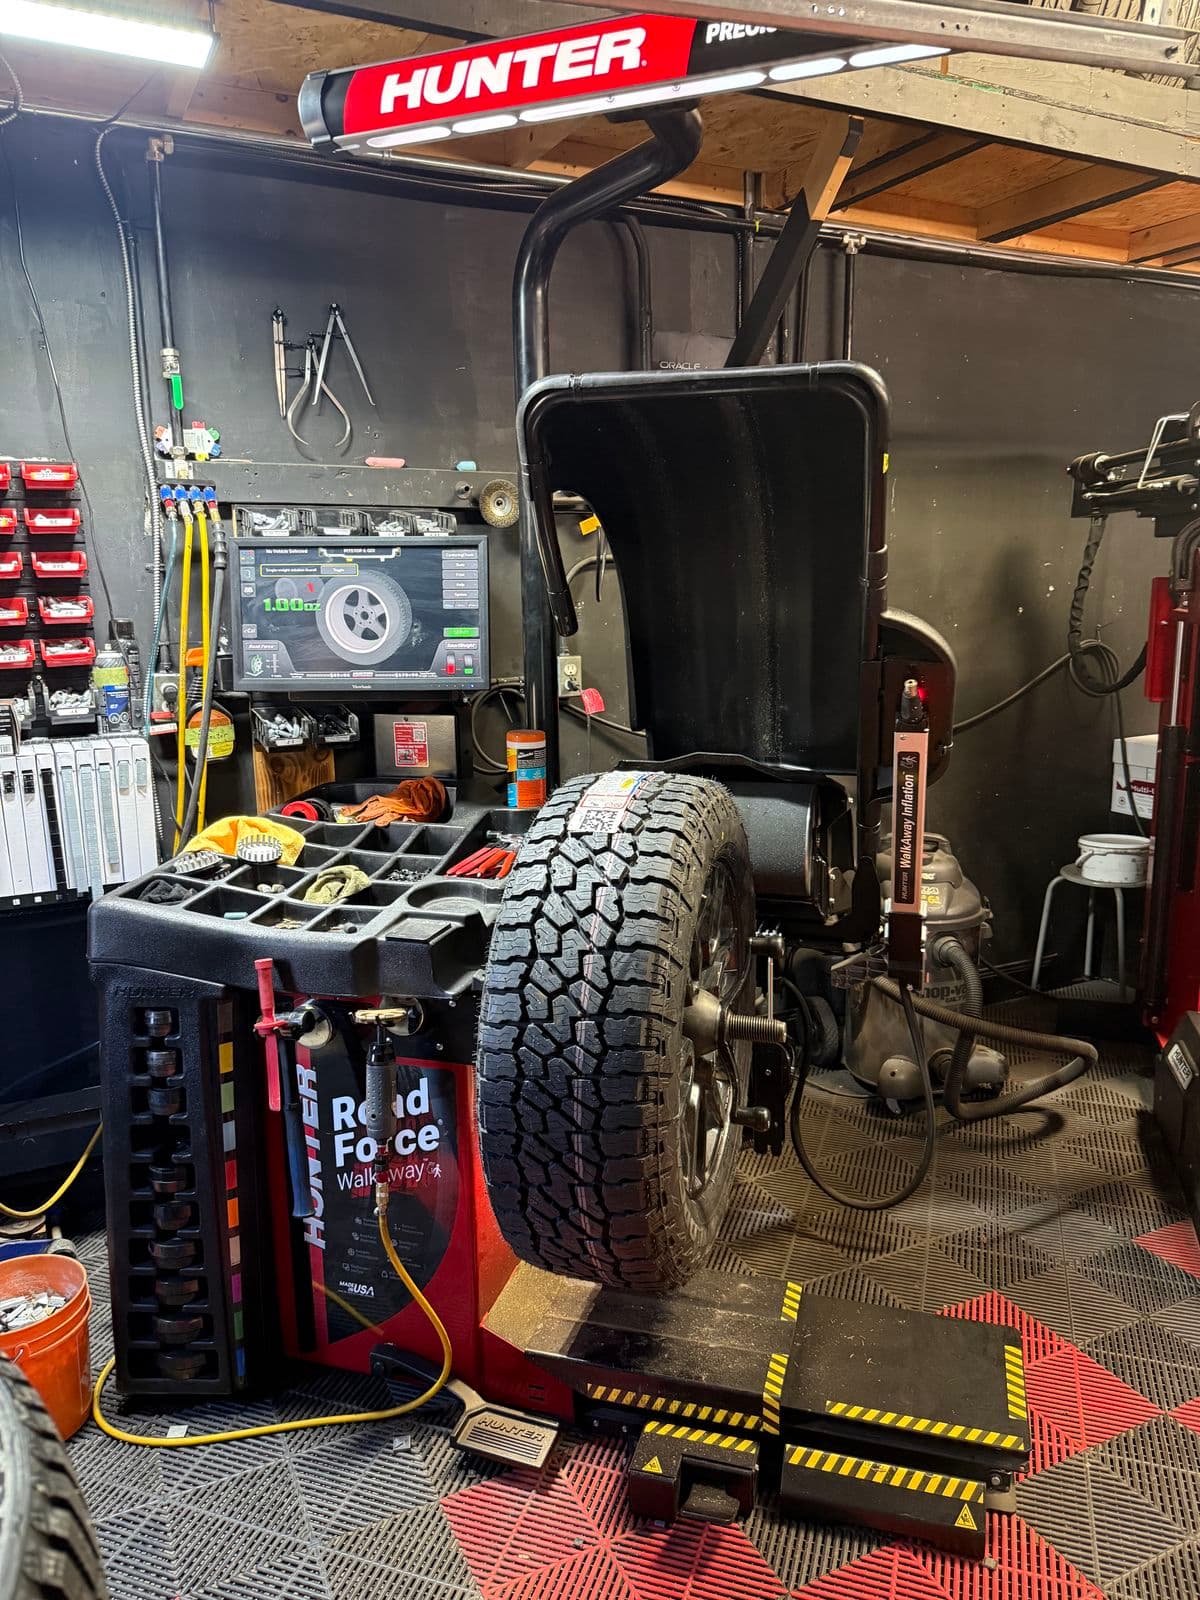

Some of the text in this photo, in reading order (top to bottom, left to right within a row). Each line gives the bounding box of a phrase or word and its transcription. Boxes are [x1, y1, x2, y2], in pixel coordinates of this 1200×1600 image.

[379, 27, 647, 114] HUNTER
[263, 598, 304, 612] 1.00
[901, 774, 914, 817] Inflation
[900, 819, 915, 868] WalkAway
[334, 1124, 440, 1168] Foce
[336, 1162, 425, 1191] Walkway
[353, 1283, 375, 1297] USA
[477, 1416, 546, 1442] HUNTER
